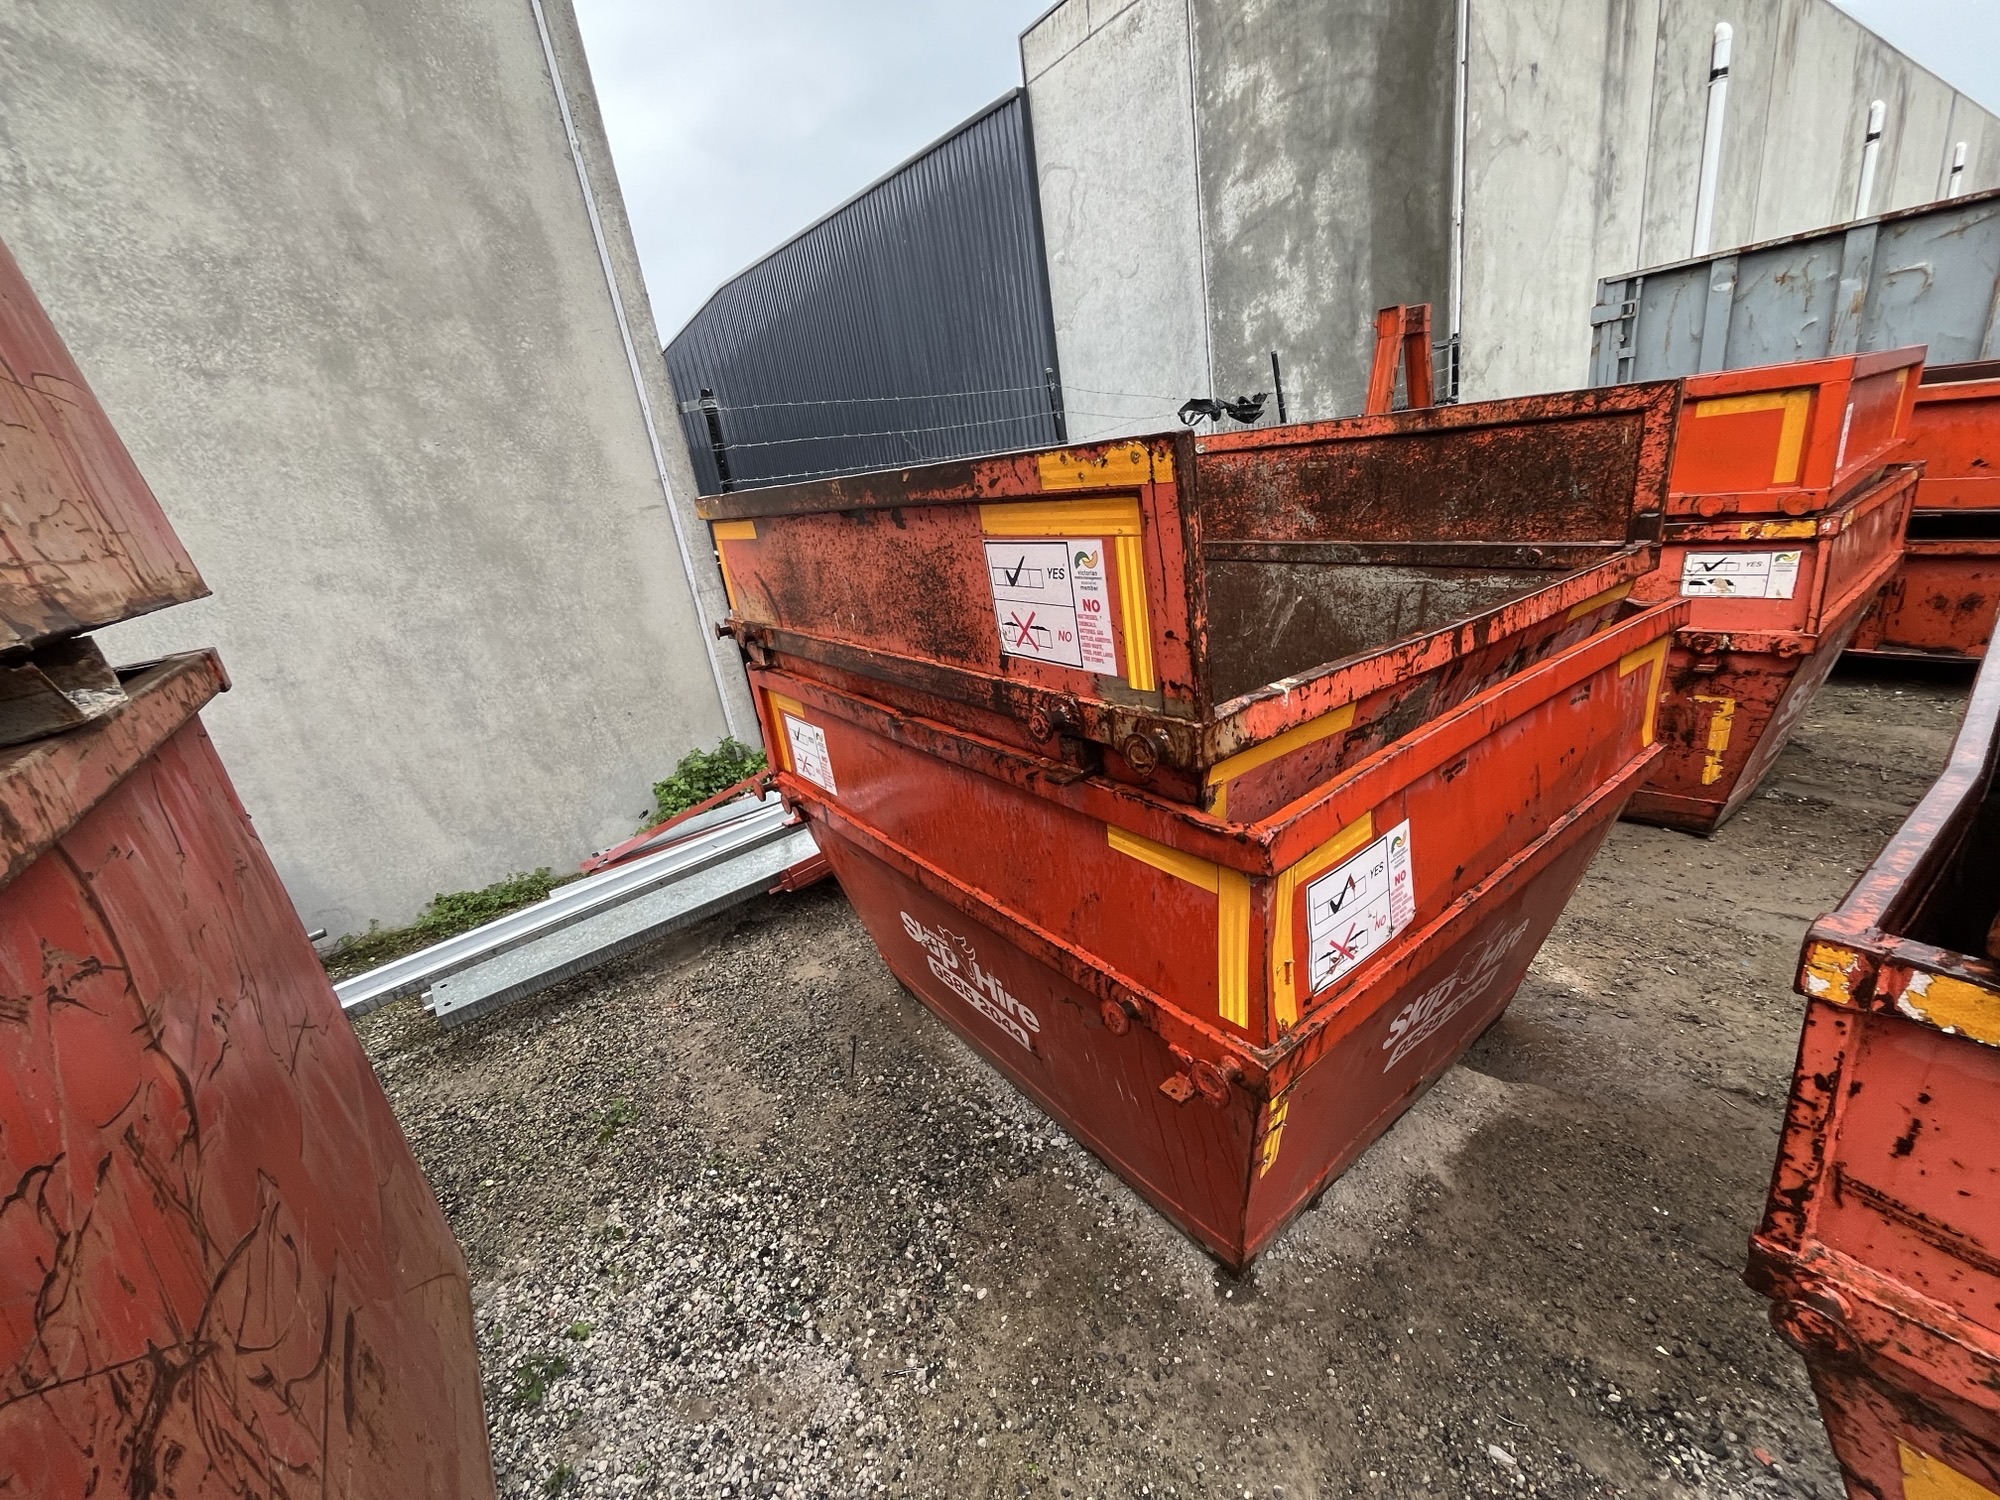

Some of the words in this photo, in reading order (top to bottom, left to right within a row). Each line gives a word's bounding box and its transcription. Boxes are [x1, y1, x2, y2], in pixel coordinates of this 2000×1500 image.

[1047, 567, 1065, 580] YES
[1082, 598, 1100, 612] NO
[1058, 630, 1072, 642] NO
[1369, 861, 1384, 879] YES
[1394, 869, 1407, 887] NO
[1375, 914, 1387, 931] NO
[900, 911, 959, 970] Skip
[972, 961, 1041, 1033] Hire
[933, 962, 975, 1002] 9585
[978, 997, 1027, 1044] 2044
[1382, 979, 1457, 1050] Skip
